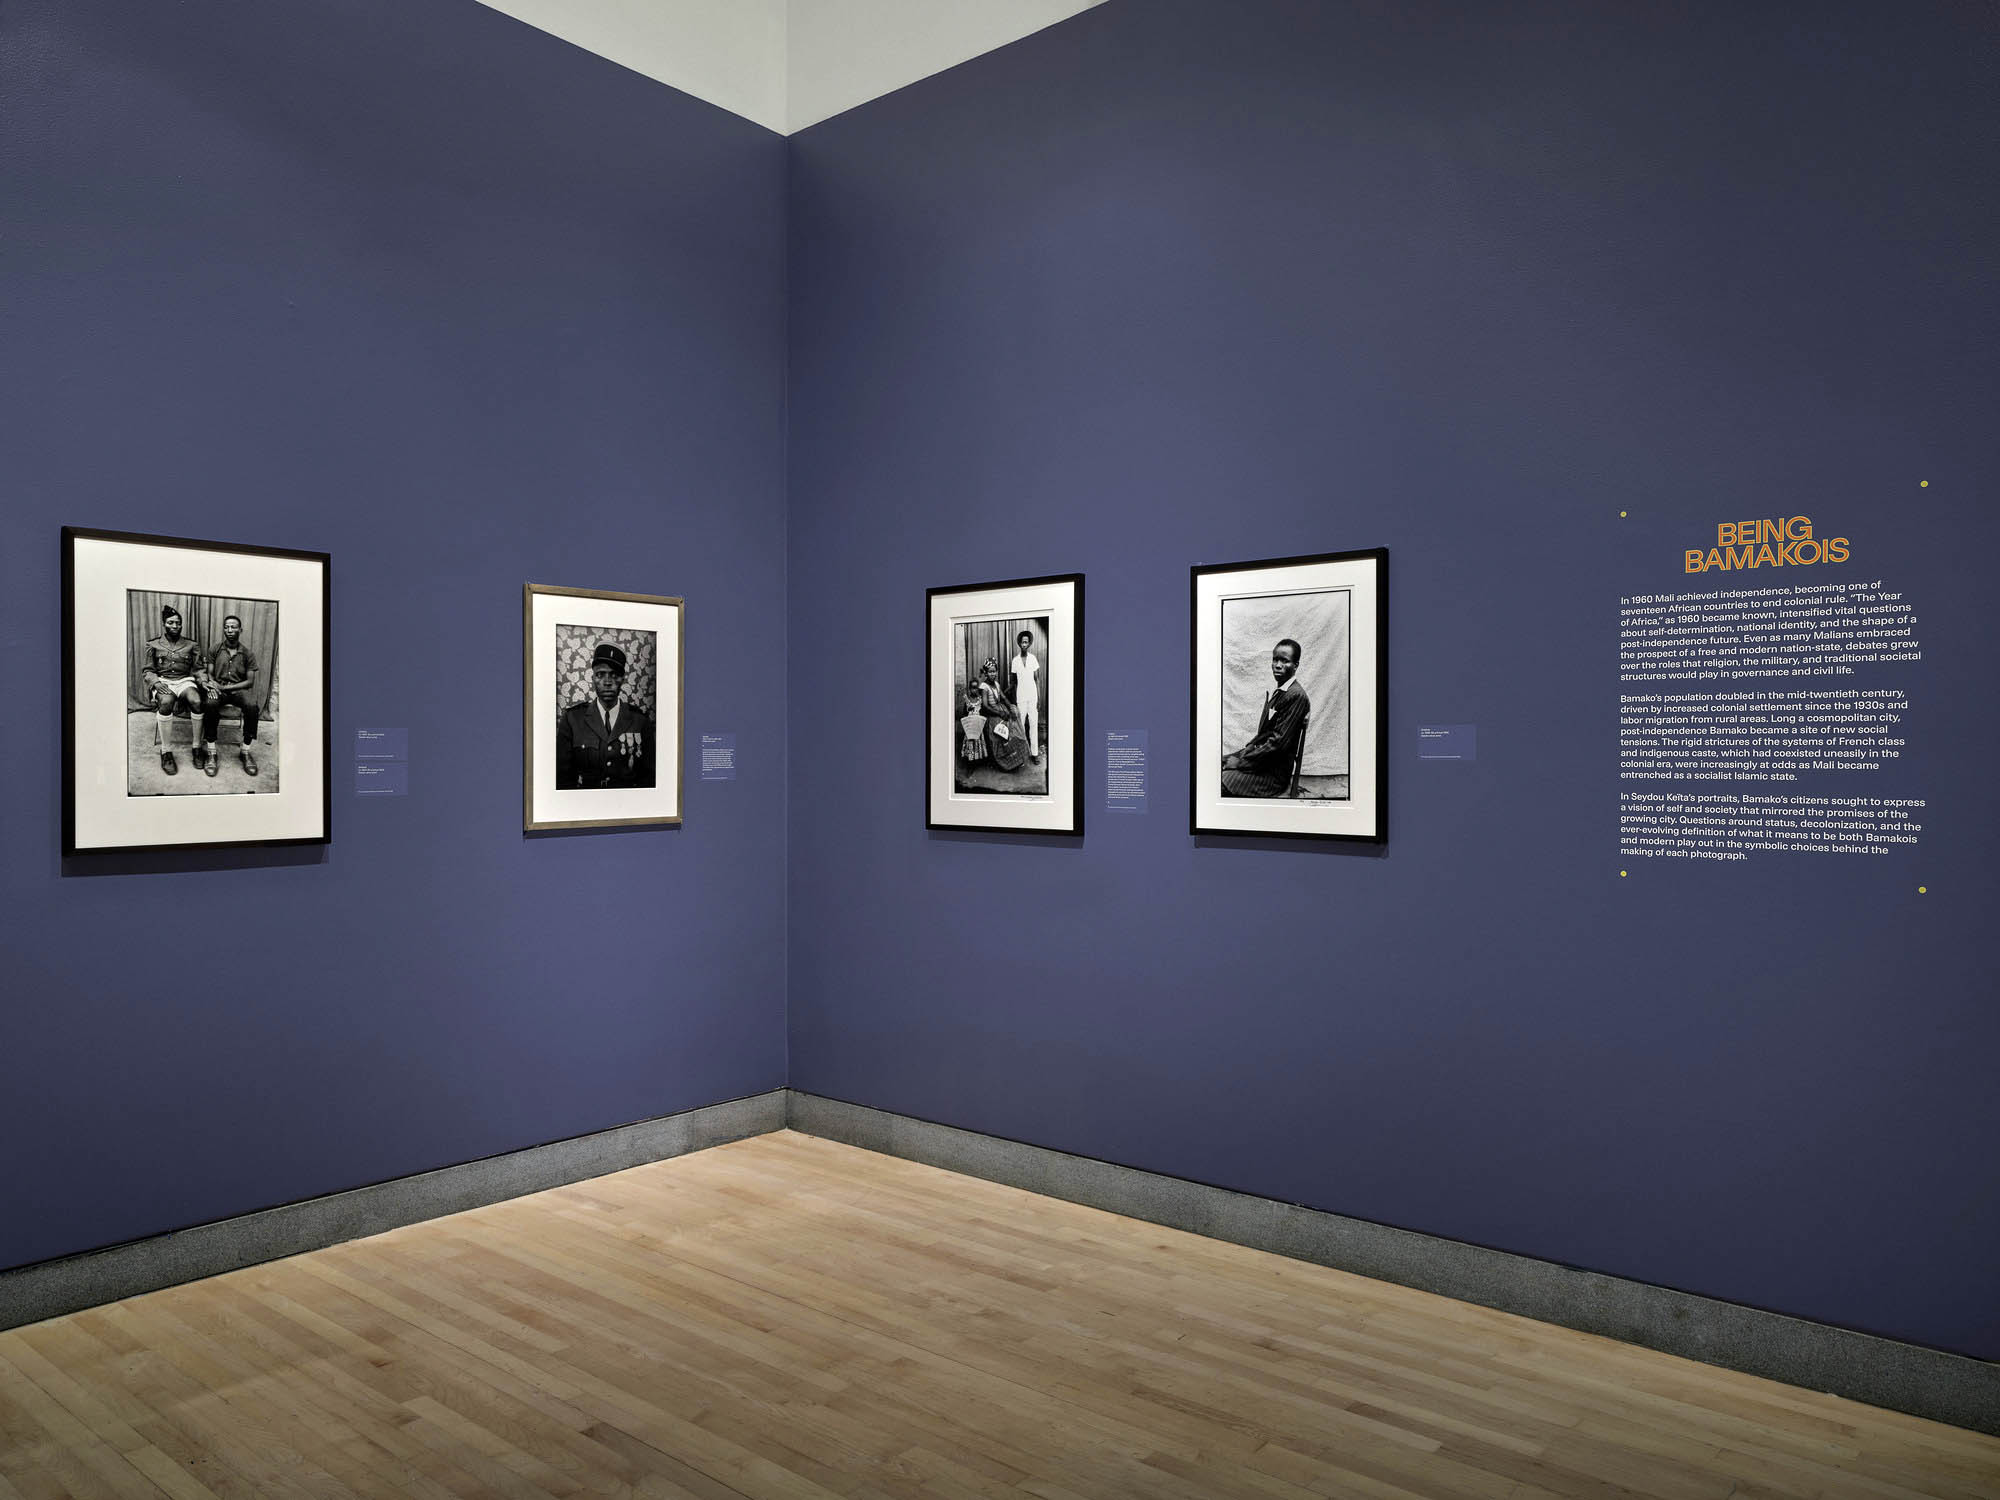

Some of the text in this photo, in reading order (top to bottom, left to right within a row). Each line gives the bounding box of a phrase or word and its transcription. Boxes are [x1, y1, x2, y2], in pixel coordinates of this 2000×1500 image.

[1717, 515, 1813, 547] BEING
[1684, 537, 1850, 574] BAMAKOIS
[1621, 597, 1629, 605] In
[1631, 595, 1653, 604] 1960
[1655, 594, 1674, 602] Mali
[1676, 591, 1718, 601] achieved
[1720, 588, 1792, 599] independence,
[1795, 584, 1846, 594] becoming
[1870, 580, 1882, 589] of
[1621, 607, 1666, 615] seventeen
[1668, 604, 1701, 612] African
[1704, 601, 1748, 610] countries
[1763, 598, 1781, 607] end
[1784, 596, 1822, 606] colonial
[1826, 595, 1848, 603] rule.
[1878, 592, 1902, 600] Year
[1620, 618, 1630, 626] of
[1677, 614, 1700, 623] 1960
[1702, 614, 1740, 622] became
[1742, 611, 1777, 620] known,
[1780, 607, 1832, 618] intensified
[1834, 606, 1856, 615] vital
[1859, 604, 1912, 615] questions
[1649, 625, 1734, 636] self-determination,
[1737, 622, 1775, 631] national
[1778, 620, 1817, 630] identity,
[1820, 619, 1839, 627] and
[1862, 617, 1894, 626] shape
[1621, 637, 1708, 650] post-independence
[1709, 636, 1741, 644] future.
[1744, 634, 1767, 643] Even
[1783, 633, 1812, 642] many
[1814, 630, 1854, 640] Malians
[1856, 627, 1911, 638] embraced
[1704, 658, 1740, 668] religion,
[1762, 656, 1800, 665] military,
[1803, 655, 1821, 663] and
[1824, 653, 1877, 662] traditional
[1880, 652, 1921, 660] societal
[1668, 670, 1697, 679] would
[1699, 670, 1719, 680] play
[1720, 670, 1729, 678] in
[1732, 669, 1789, 679] governance
[1792, 667, 1811, 676] and
[1813, 666, 1833, 675] civil
[1836, 666, 1854, 674] life.
[1664, 693, 1713, 703] population
[1715, 692, 1754, 700] doubled
[1768, 691, 1784, 699] the
[1787, 690, 1859, 699] mid-twentieth
[1862, 690, 1904, 699] century,
[1651, 705, 1662, 714] by
[1664, 704, 1708, 712] increased
[1805, 702, 1831, 710] since
[1854, 701, 1884, 709] 1930s
[1888, 701, 1908, 709] and
[1621, 727, 1707, 736] post-independence
[1710, 726, 1748, 734] Bamako
[1750, 726, 1789, 734] became
[1800, 726, 1818, 734] site
[1820, 725, 1831, 734] of
[1858, 725, 1888, 733] social
[1682, 738, 1702, 747] rigid
[1783, 738, 1823, 747] systems
[1878, 737, 1904, 745] class
[1701, 760, 1757, 770] increasingly
[1838, 761, 1879, 769] became
[1620, 771, 1672, 779] entrenched
[1694, 771, 1732, 780] socialist
[1734, 772, 1768, 780] Islamic
[1631, 793, 1664, 802] Seydou
[1698, 795, 1739, 803] portraits,
[1790, 796, 1828, 804] citizens
[1832, 797, 1868, 807] sought
[1621, 815, 1657, 824] growing
[1660, 816, 1677, 825] city.
[1680, 816, 1726, 825] Questions
[1765, 820, 1798, 828] status,
[1800, 820, 1877, 830] decolonization,
[1904, 823, 1921, 831] the
[1621, 826, 1679, 836] ever-evolving
[1682, 827, 1725, 836] definition
[1739, 829, 1764, 838] what
[1766, 830, 1772, 838] it
[1824, 832, 1836, 840] be
[1839, 832, 1863, 841] both
[1866, 833, 1917, 843] Bamakois
[1640, 837, 1675, 845] modern
[1677, 838, 1696, 848] play
[1727, 840, 1742, 848] the
[1745, 841, 1788, 850] symbolic
[1791, 843, 1829, 852] choices
[1832, 844, 1868, 853] behind
[1871, 846, 1888, 854] the
[1621, 847, 1654, 857] making
[1655, 848, 1664, 856] of
[1690, 850, 1748, 861] photograph.
